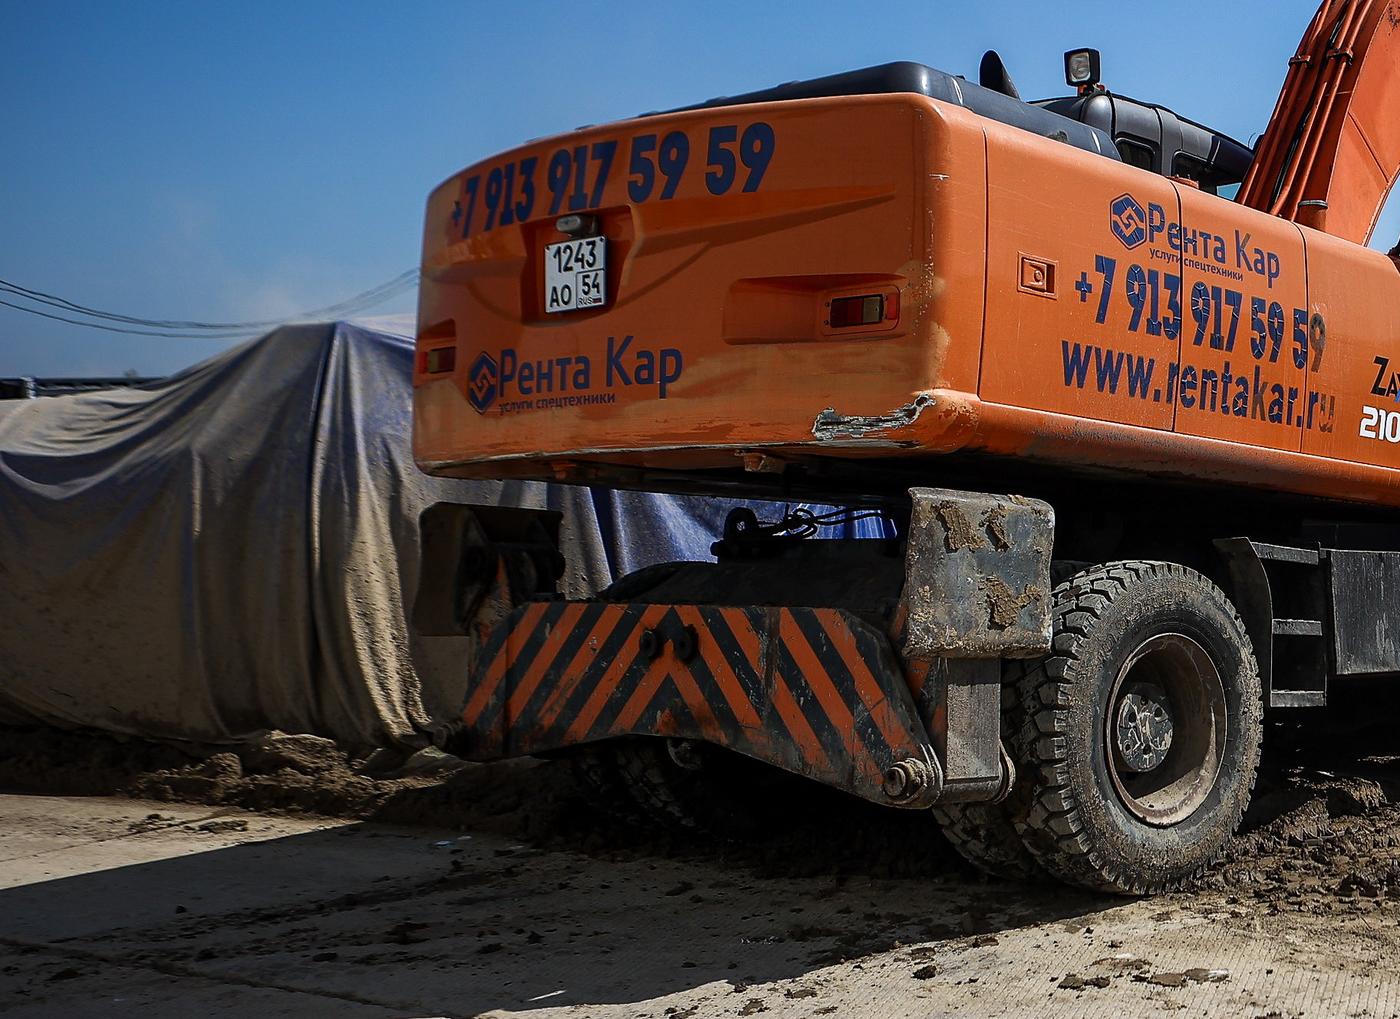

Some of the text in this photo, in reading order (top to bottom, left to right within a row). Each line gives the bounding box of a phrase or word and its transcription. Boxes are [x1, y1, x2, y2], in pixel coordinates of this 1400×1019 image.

[452, 122, 775, 239] +7 913 917 59 59
[553, 240, 597, 273] 1243
[1148, 202, 1280, 288] Рента Кар
[1184, 258, 1244, 282] спецтехники
[582, 272, 600, 295] 54
[1075, 254, 1326, 373] +7 913 917 59 59
[499, 335, 683, 399] Рента Кар
[1061, 340, 1336, 433] www.rentakar.ru
[536, 393, 616, 410] спецтехники
